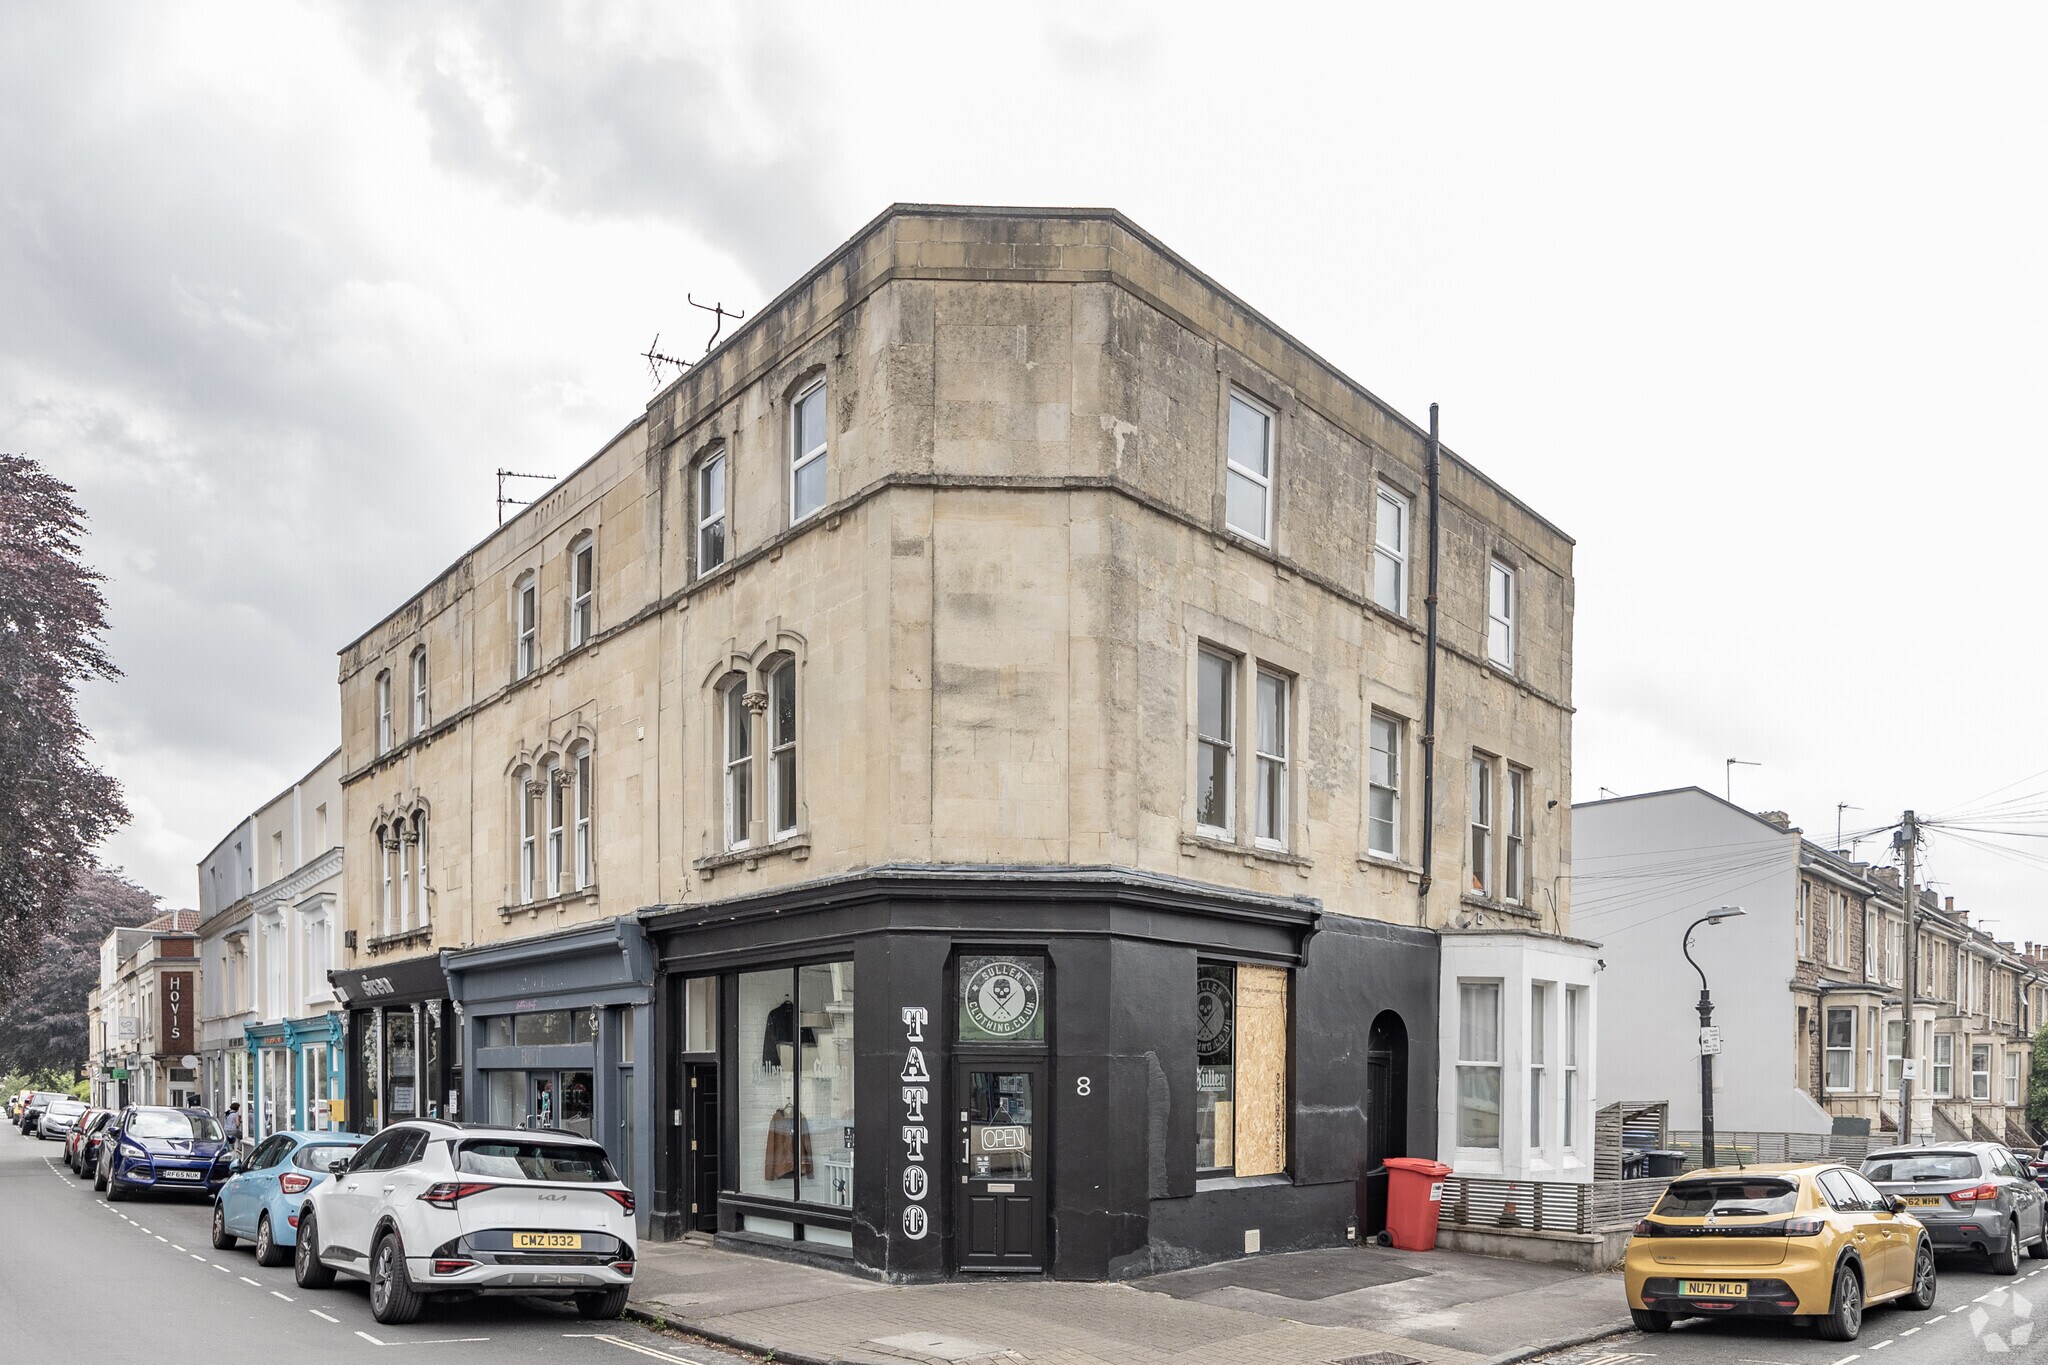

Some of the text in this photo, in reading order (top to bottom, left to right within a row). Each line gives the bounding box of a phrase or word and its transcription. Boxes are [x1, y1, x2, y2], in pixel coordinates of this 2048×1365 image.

[981, 965, 1023, 980] SULLEN
[361, 974, 395, 996] siren
[1197, 981, 1223, 997] LLEN
[170, 976, 180, 1039] HOVIS
[969, 1001, 1036, 1032] CLOTHING.CO.UK
[1077, 1076, 1091, 1096] 8
[900, 1006, 930, 1241] TATTOO
[984, 1128, 1023, 1148] OPEN
[1905, 1197, 1940, 1206] 62 WHW
[520, 1234, 574, 1247] CMZ 1332
[1689, 1283, 1742, 1295] NU71 WLO
